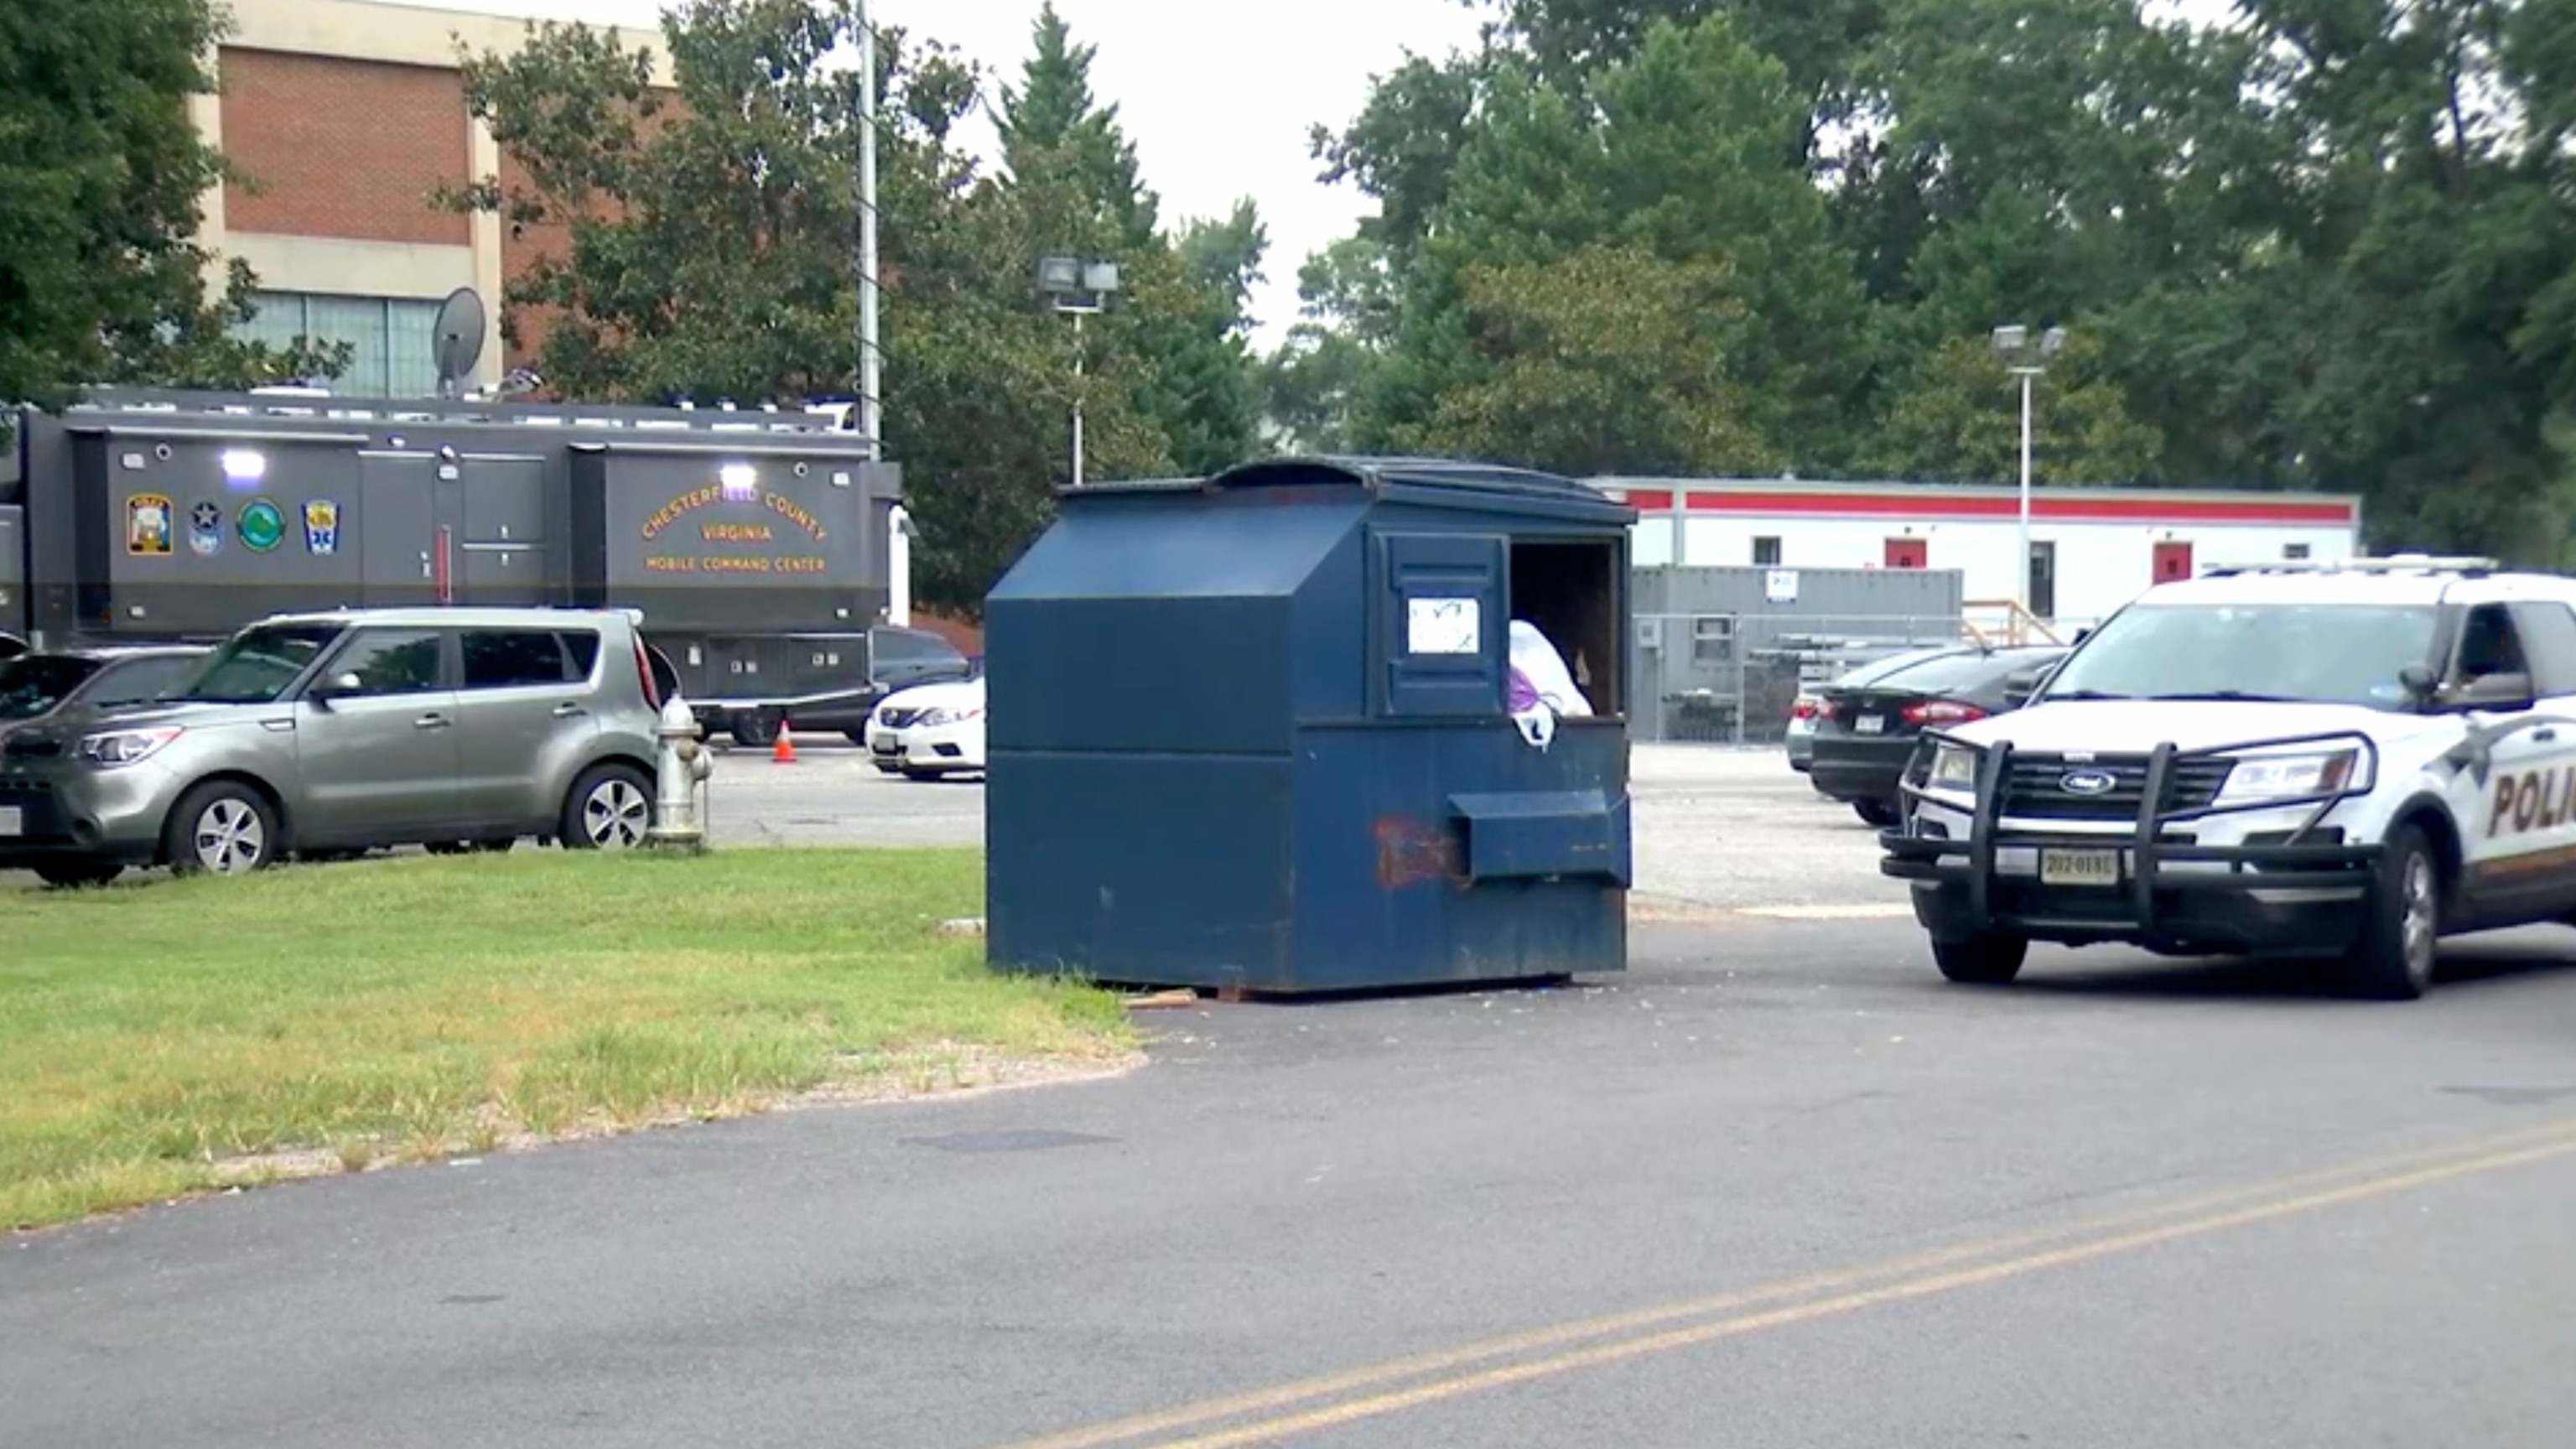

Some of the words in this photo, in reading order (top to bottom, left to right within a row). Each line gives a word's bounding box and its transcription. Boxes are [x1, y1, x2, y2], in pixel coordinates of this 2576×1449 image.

[641, 485, 758, 541] CHESTERFIELD
[764, 491, 828, 542] COUNTY
[701, 524, 773, 541] VIRGINIA
[645, 557, 696, 574] MOBILE
[702, 557, 770, 574] COMMAND
[774, 557, 825, 574] CENTER
[2485, 766, 2576, 839] POLI
